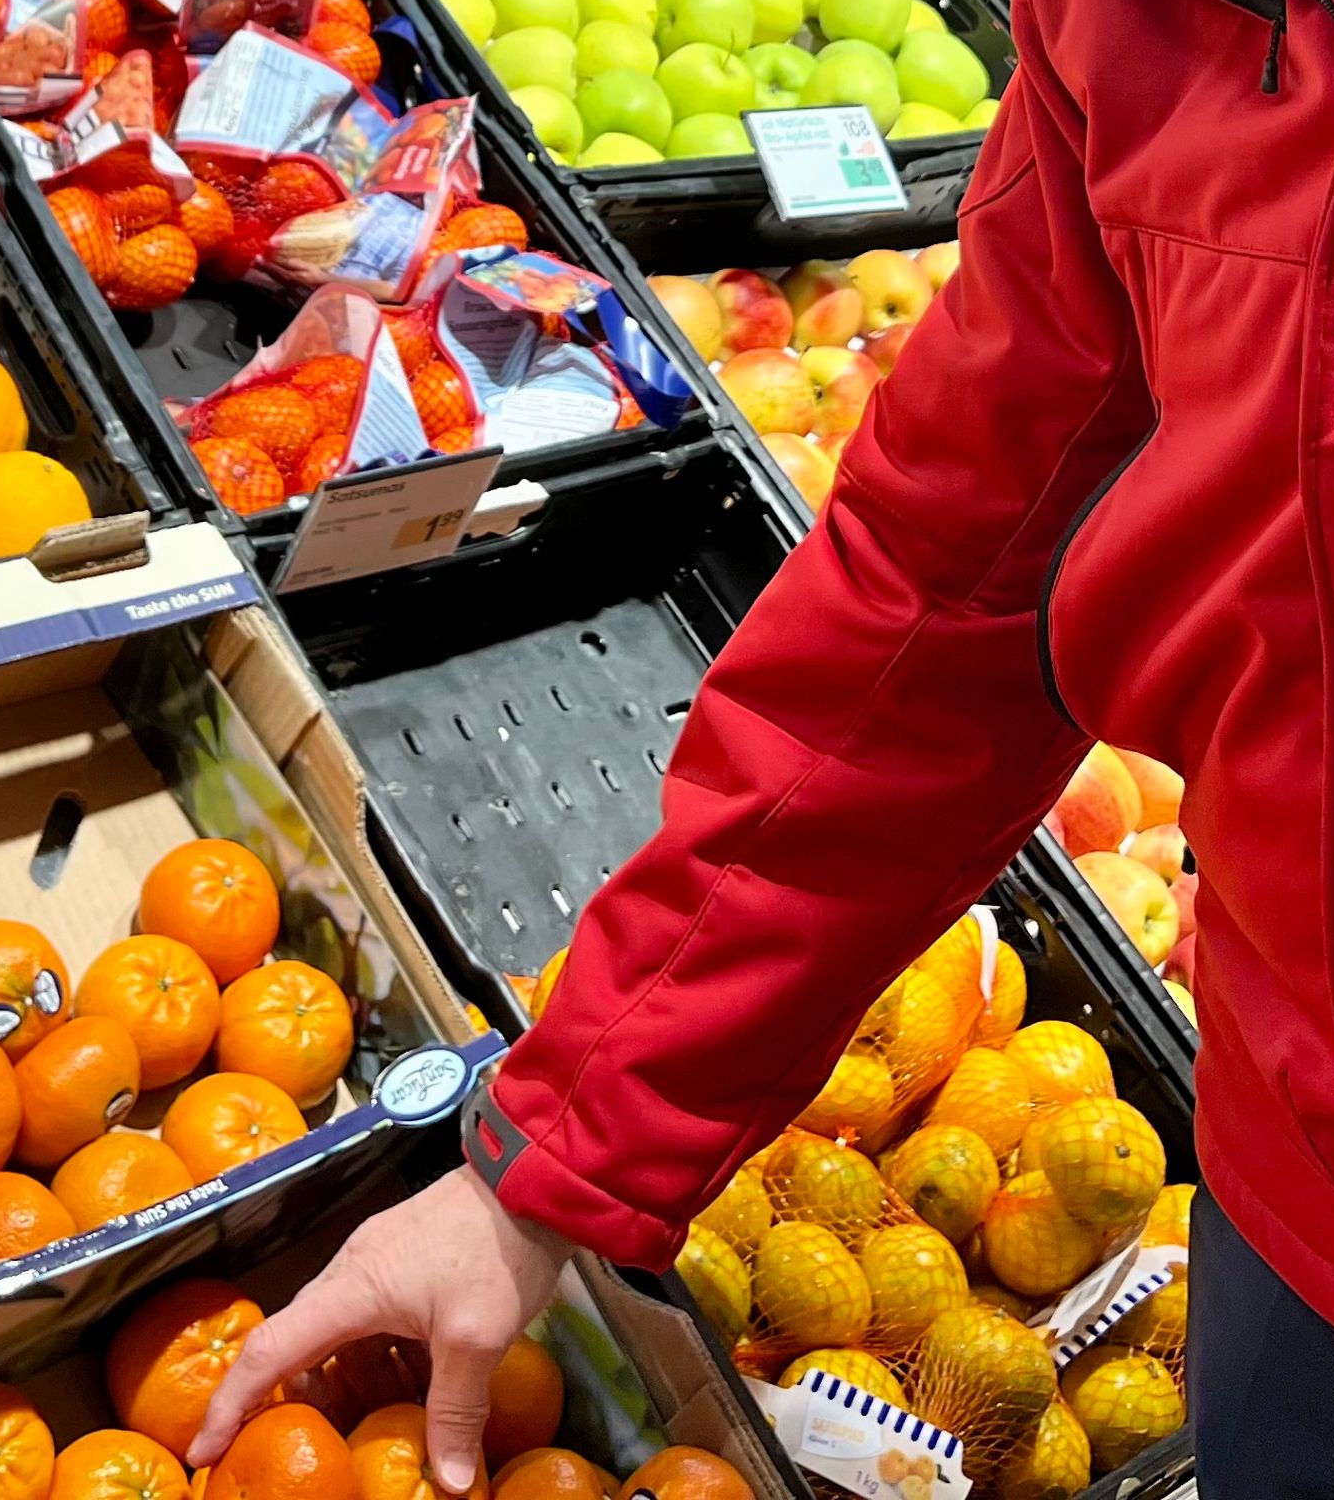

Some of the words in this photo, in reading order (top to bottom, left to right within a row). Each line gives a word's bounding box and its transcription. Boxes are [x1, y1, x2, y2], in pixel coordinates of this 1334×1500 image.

[326, 481, 407, 505] Satsumas
[124, 601, 171, 620] Taste
[170, 593, 200, 610] the
[198, 582, 235, 602] SUN
